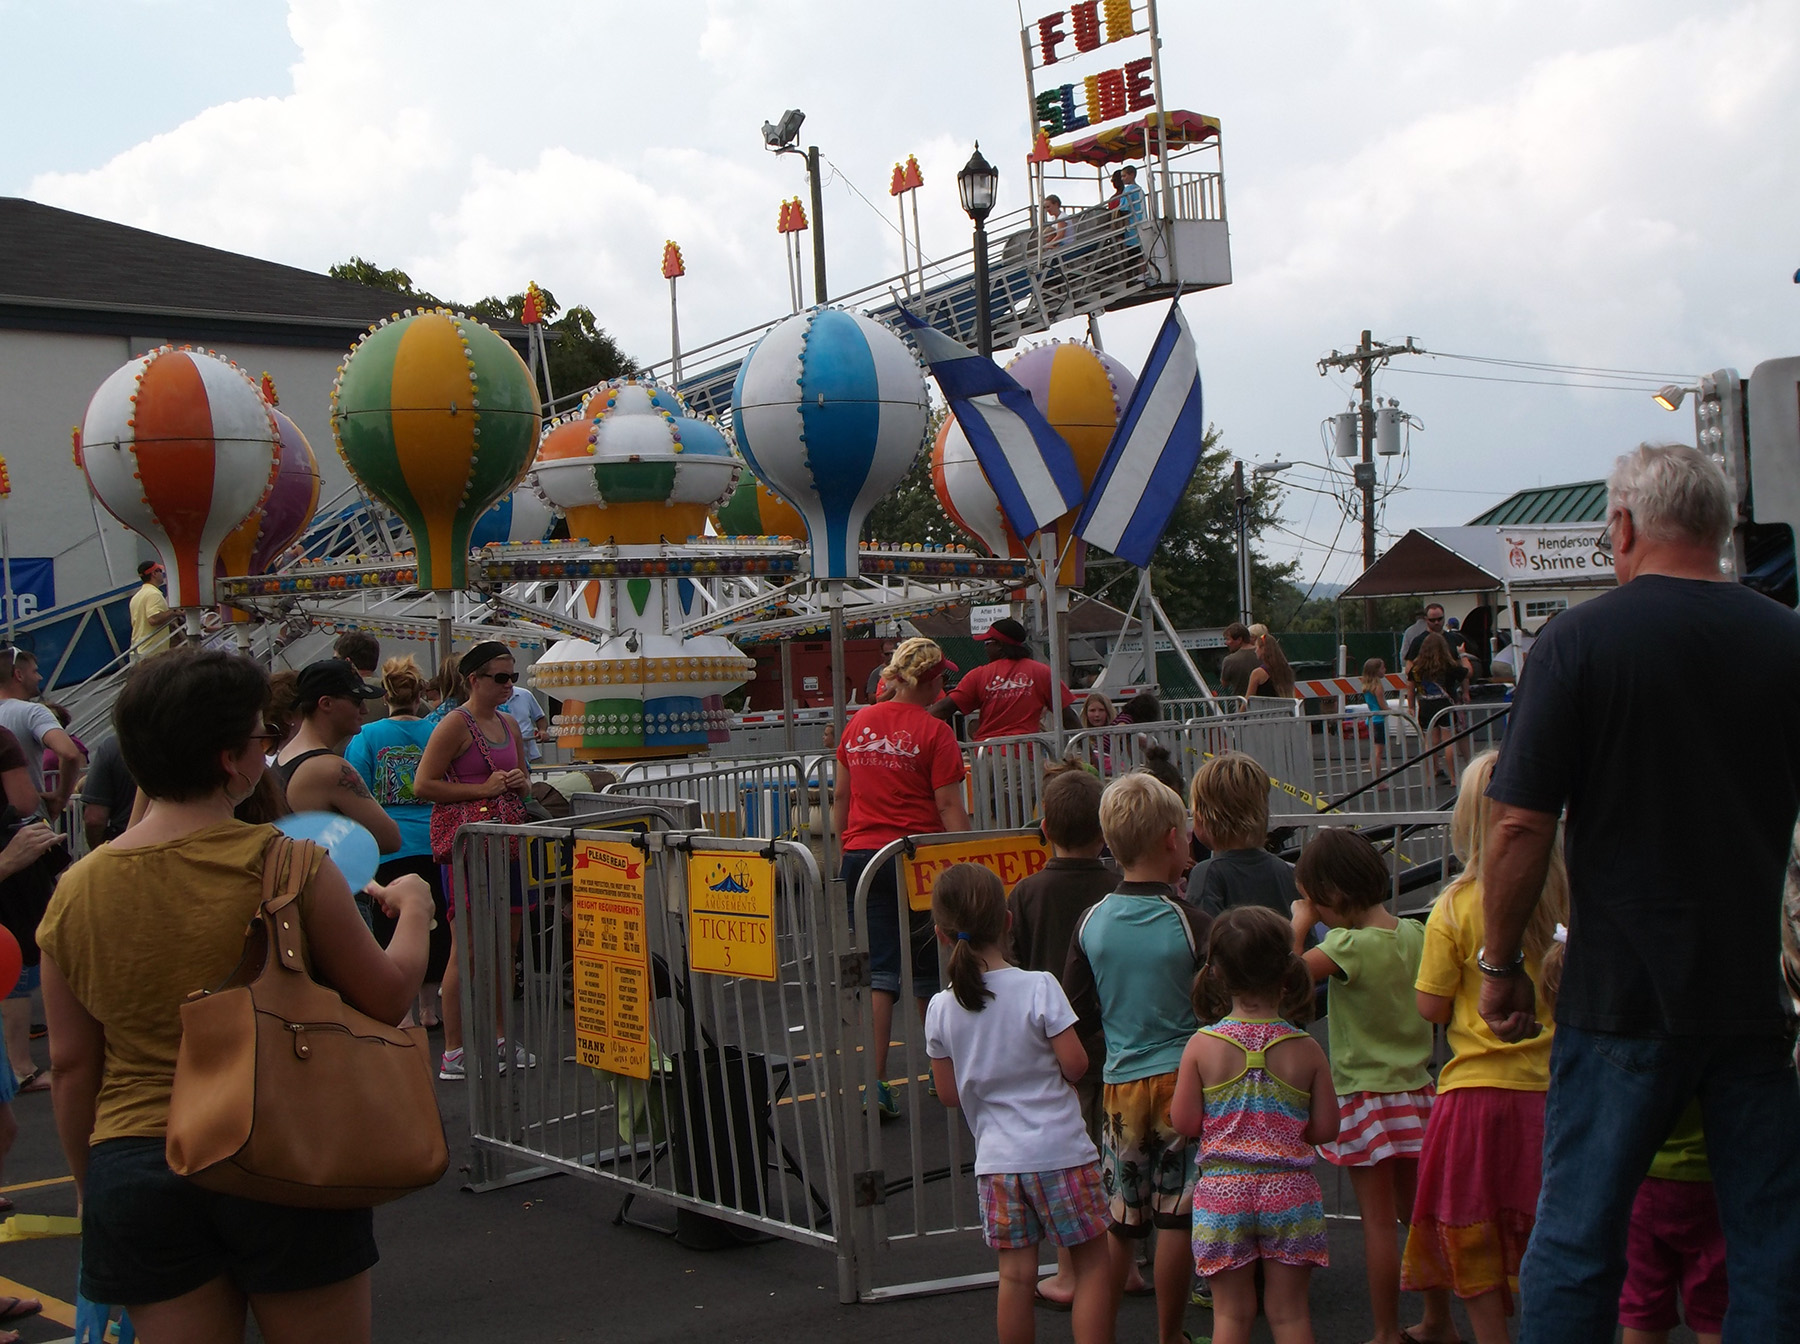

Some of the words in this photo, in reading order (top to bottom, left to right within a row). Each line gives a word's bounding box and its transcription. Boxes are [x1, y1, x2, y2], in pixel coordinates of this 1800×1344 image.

[1038, 0, 1136, 65] FUN
[1036, 57, 1156, 137] SLIDE
[1530, 553, 1586, 570] Shrine
[588, 849, 610, 864] PLEASE
[610, 856, 627, 869] READ
[911, 849, 1047, 897] EER
[705, 893, 756, 902] PALMETTO
[705, 900, 757, 912] AMUSEMENTS
[576, 900, 598, 910] HEIGHT
[598, 902, 641, 916] REQUIREMENTS:
[699, 918, 767, 945] TICKETS
[724, 946, 732, 967] 3
[577, 1037, 606, 1054] THANK
[582, 1052, 600, 1066] YOU
